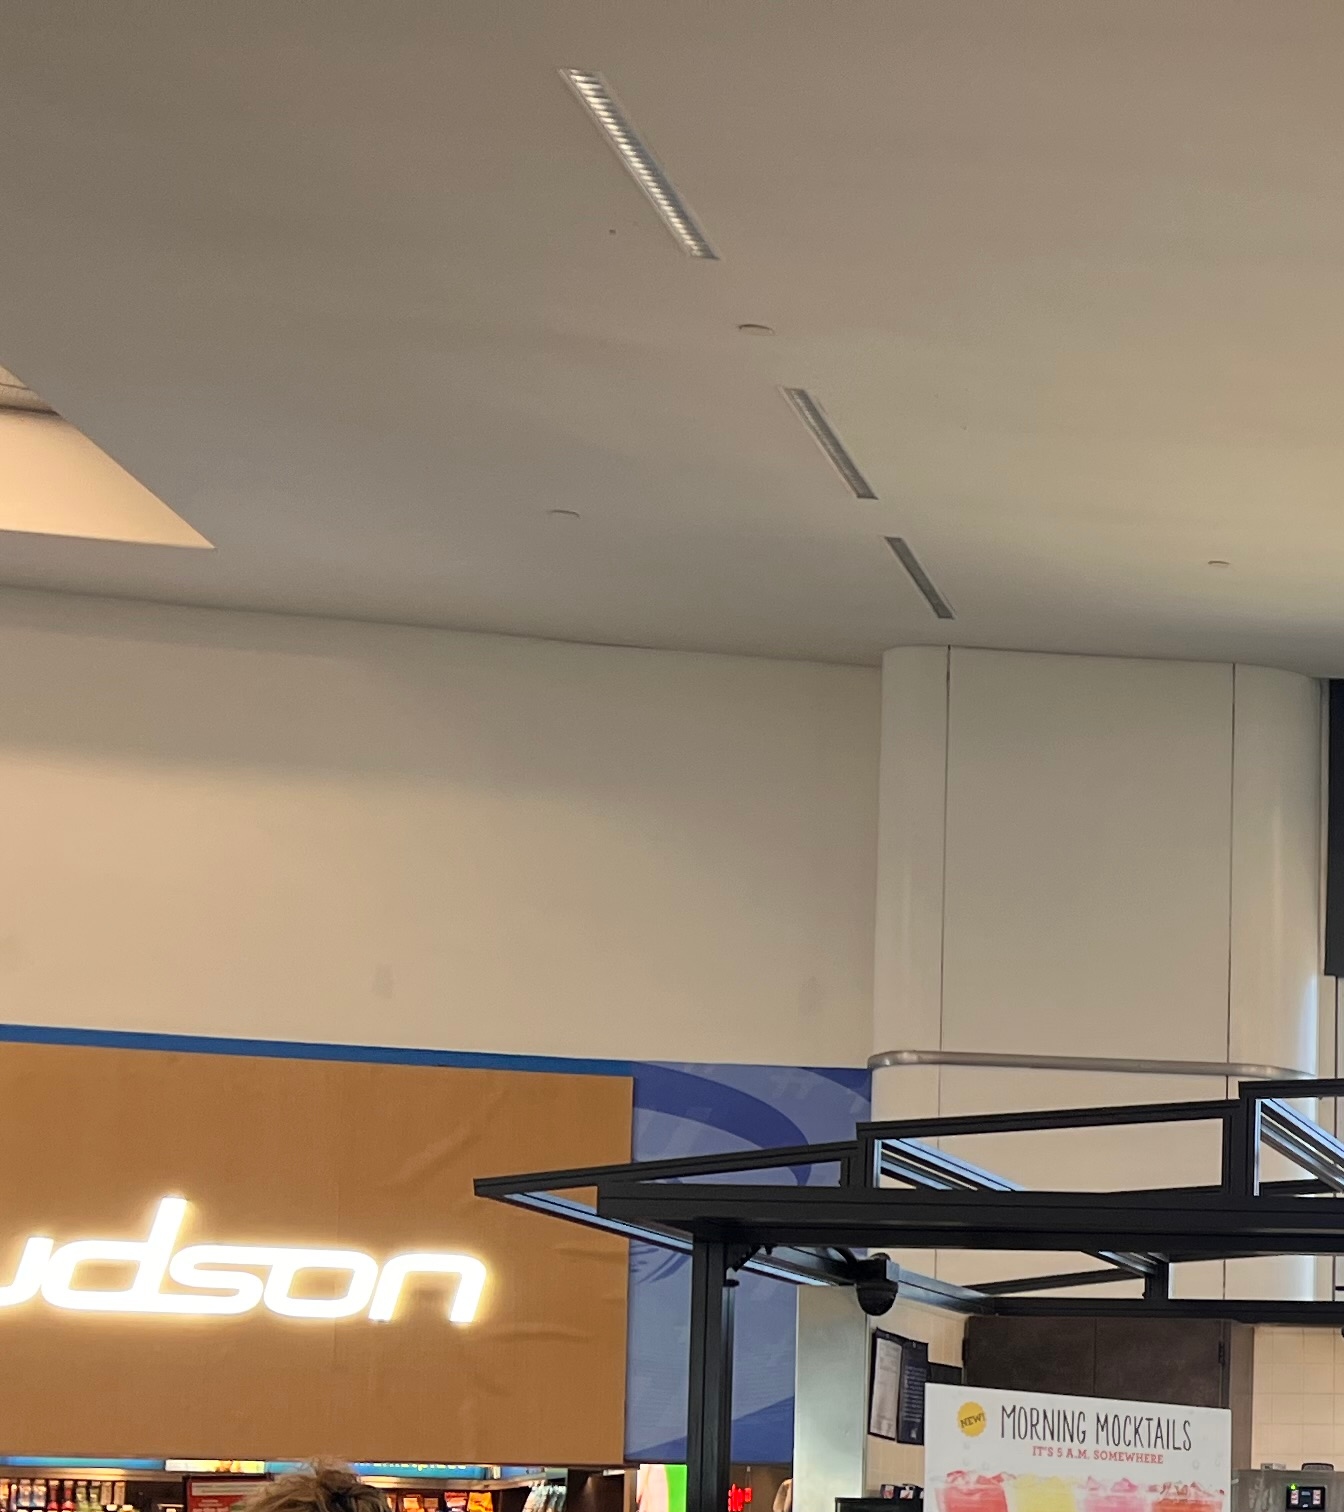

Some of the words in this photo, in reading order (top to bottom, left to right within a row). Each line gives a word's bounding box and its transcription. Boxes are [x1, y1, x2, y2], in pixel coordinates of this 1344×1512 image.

[960, 1413, 986, 1429] NEW!
[1000, 1404, 1087, 1445] MORNING
[1095, 1411, 1193, 1452] MOCKTAILS
[1032, 1445, 1056, 1458] IT'S
[1056, 1447, 1063, 1458] 5
[1093, 1450, 1164, 1465] SOMEWHERE
